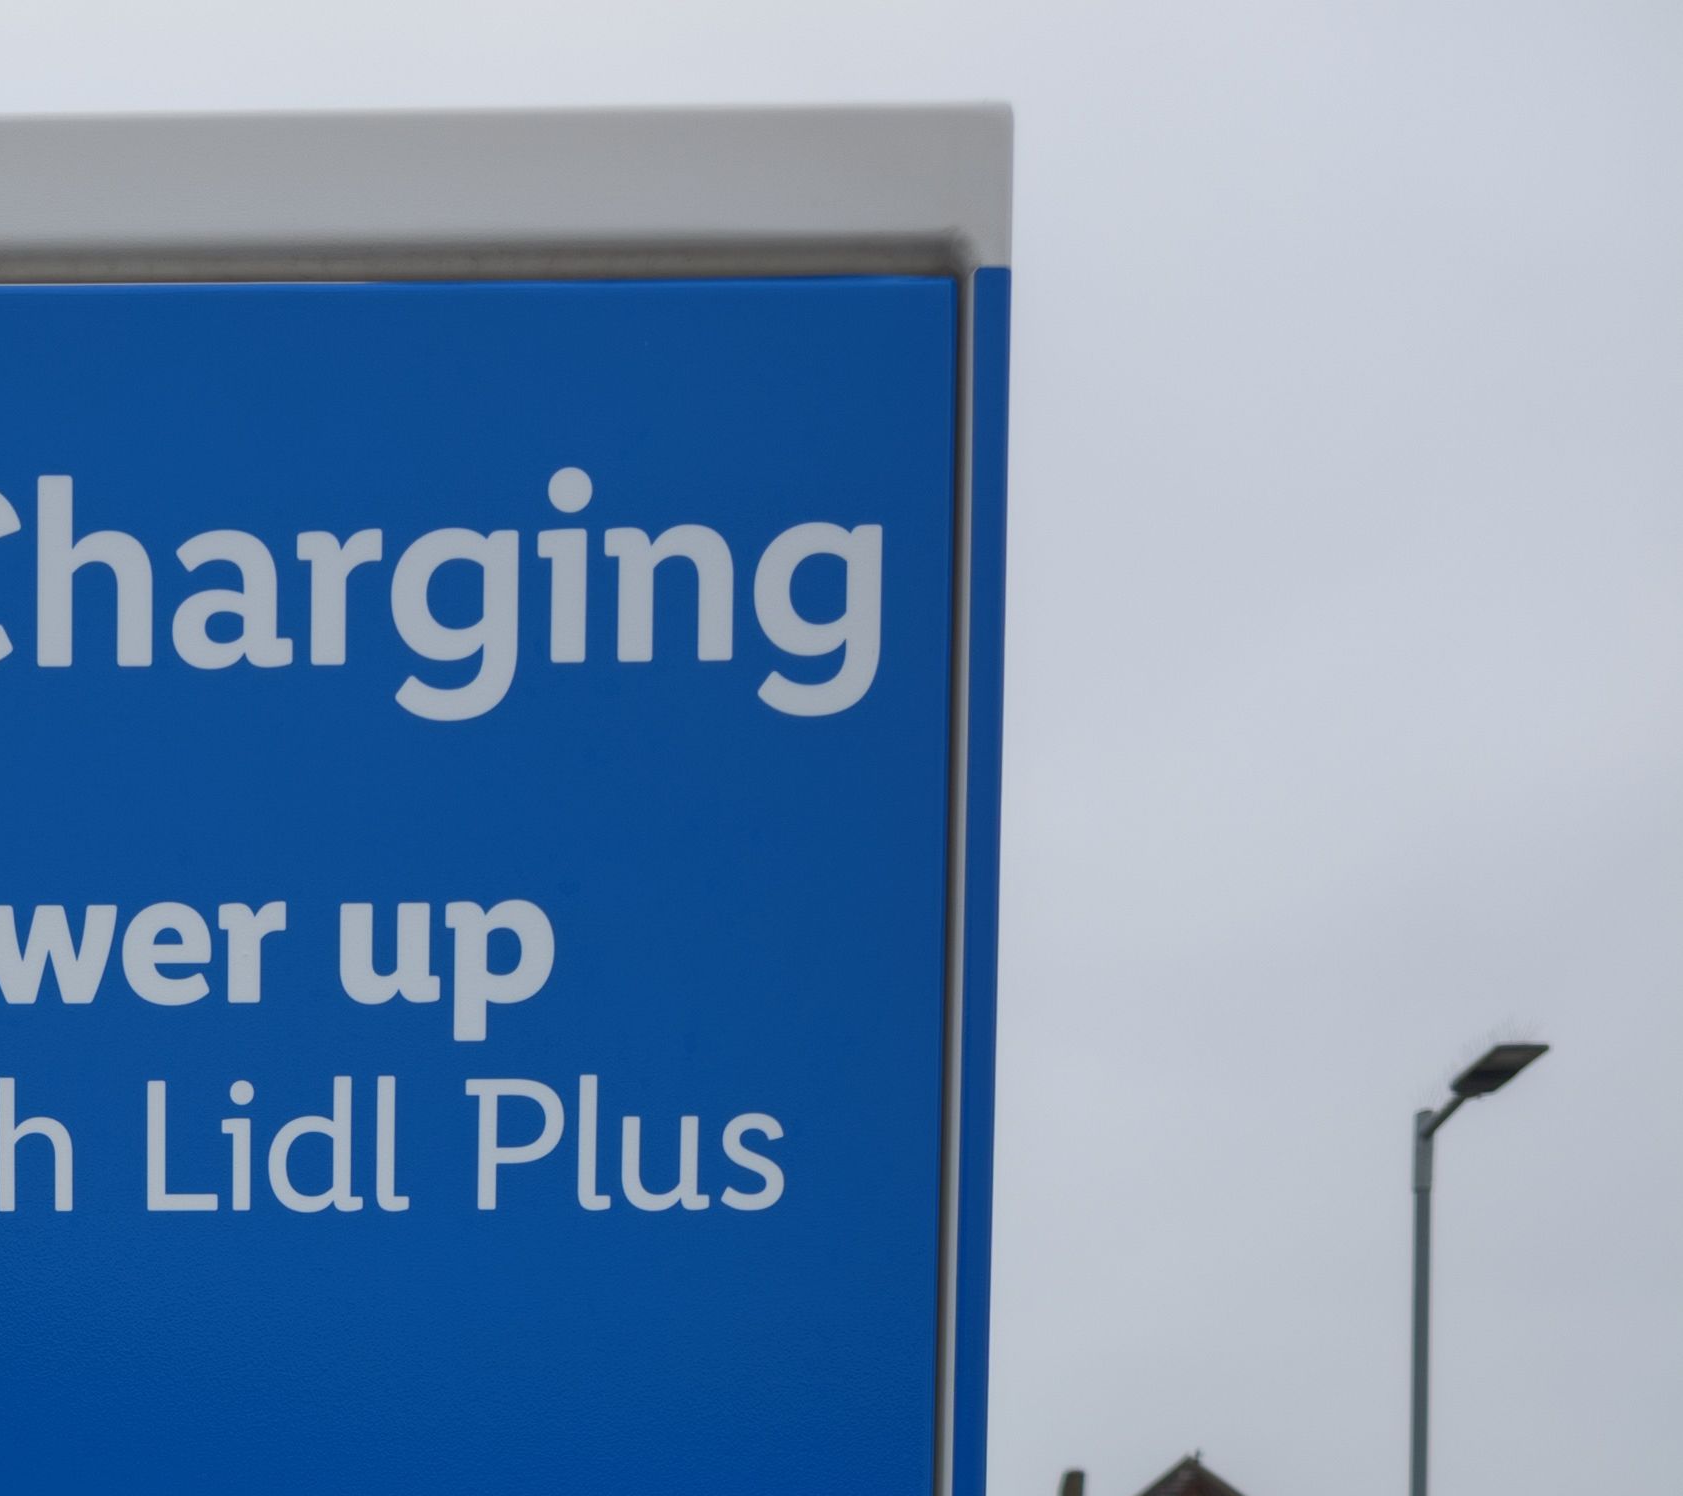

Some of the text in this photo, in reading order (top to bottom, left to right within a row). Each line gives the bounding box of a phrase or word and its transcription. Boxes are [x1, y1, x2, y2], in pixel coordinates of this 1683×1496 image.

[340, 900, 554, 1041] up
[147, 1076, 409, 1213] Lidl
[466, 1075, 784, 1211] Plus
